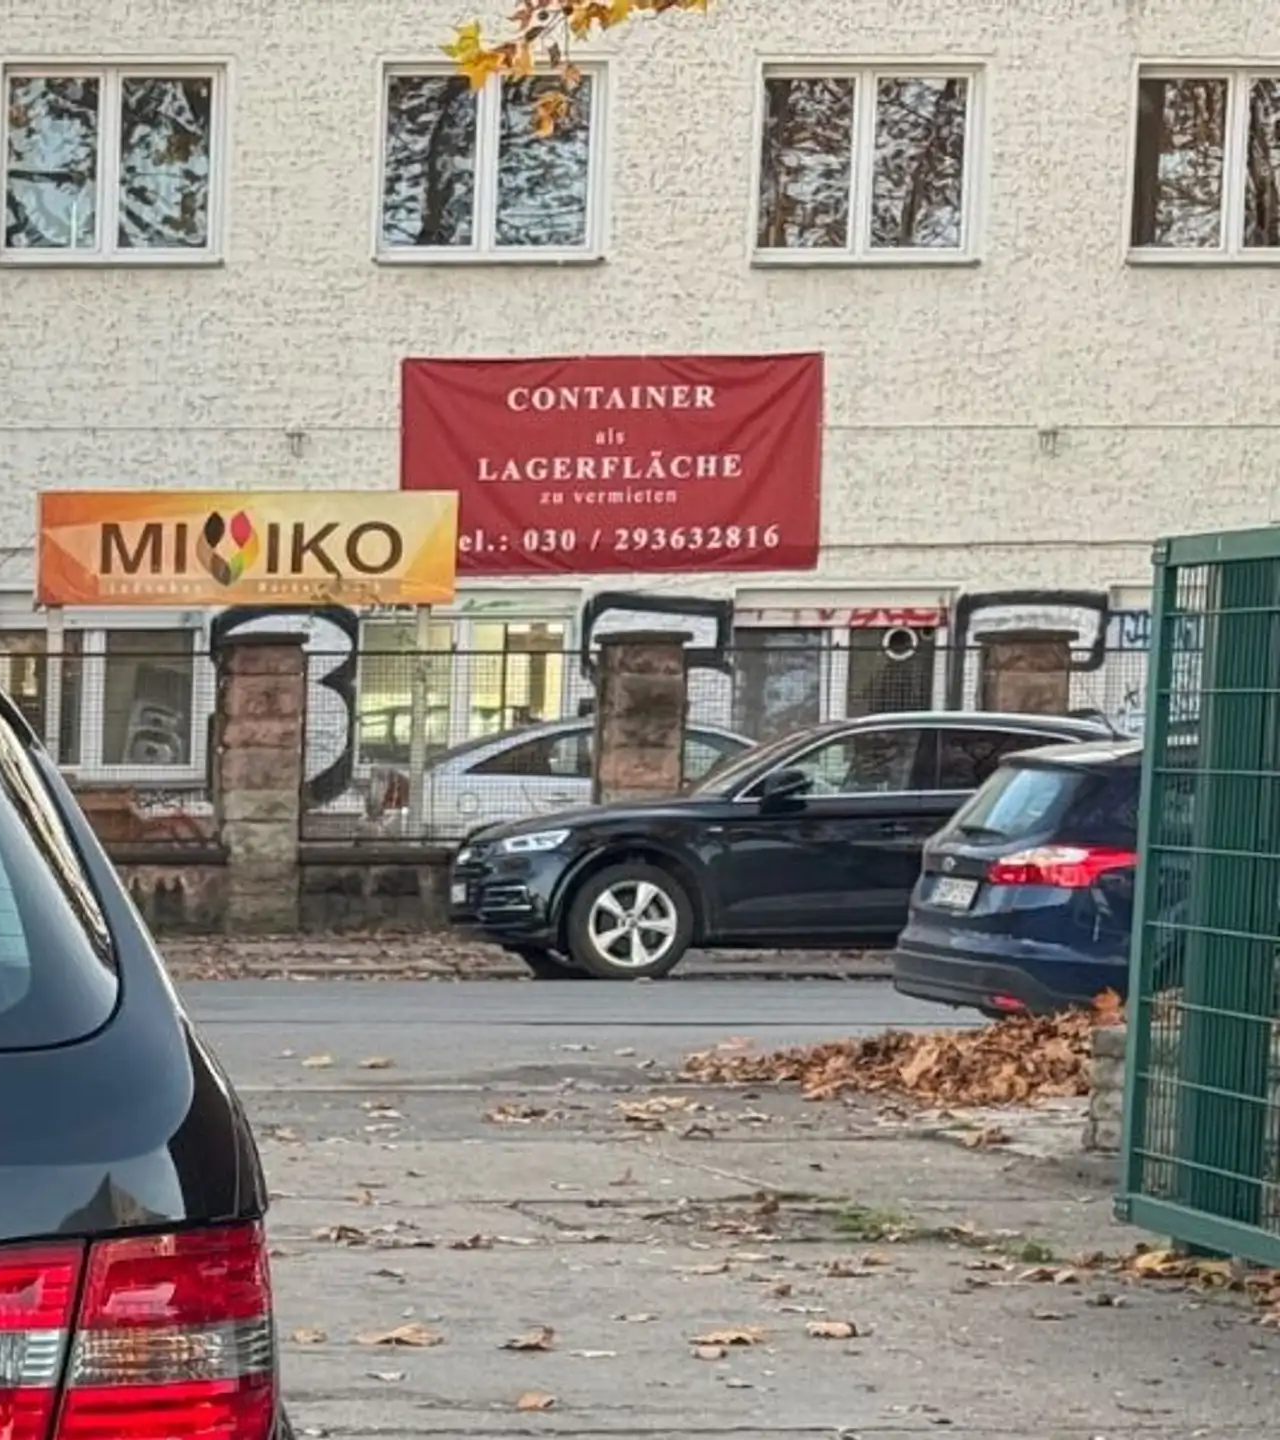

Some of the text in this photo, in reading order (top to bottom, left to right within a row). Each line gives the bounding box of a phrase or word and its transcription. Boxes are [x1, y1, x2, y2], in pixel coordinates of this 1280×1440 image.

[507, 385, 717, 412] CONTAINER
[595, 428, 626, 446] als
[478, 450, 744, 482] LAGERFLÄCHE
[539, 486, 678, 504] zu vermieten
[458, 525, 780, 552] el.: 030 / 293632816
